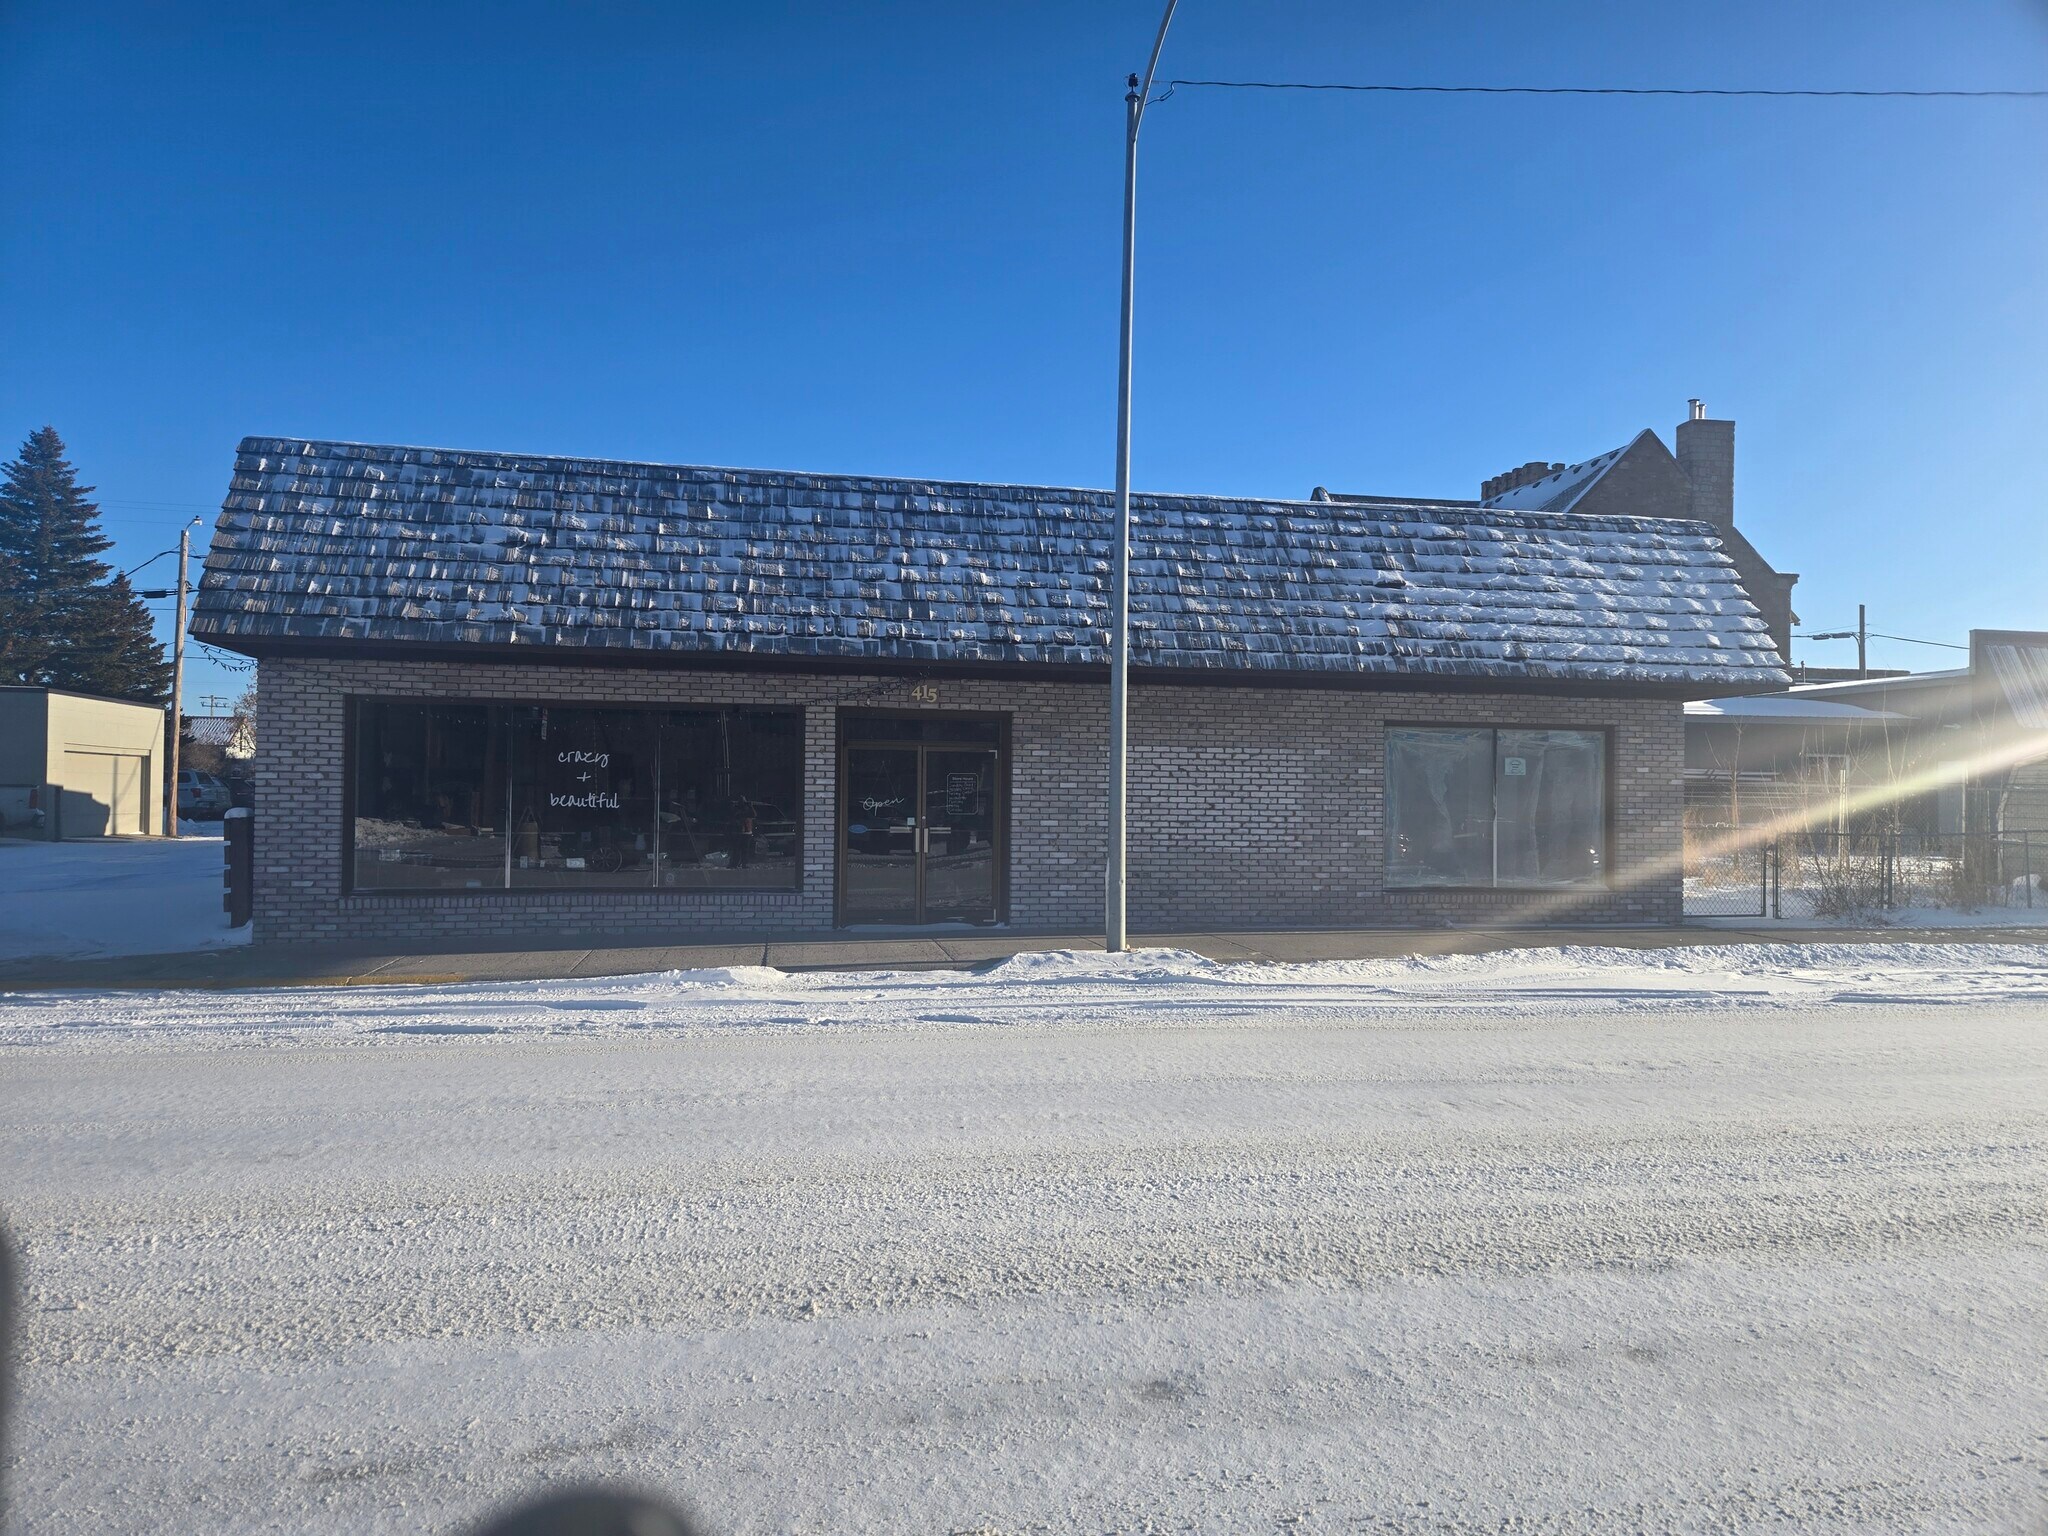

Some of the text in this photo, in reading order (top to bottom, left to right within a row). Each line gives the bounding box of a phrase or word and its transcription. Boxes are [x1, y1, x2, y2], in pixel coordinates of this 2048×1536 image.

[911, 684, 938, 703] 415
[558, 750, 610, 768] crazy
[550, 792, 620, 809] beautiful
[862, 797, 905, 817] Open
